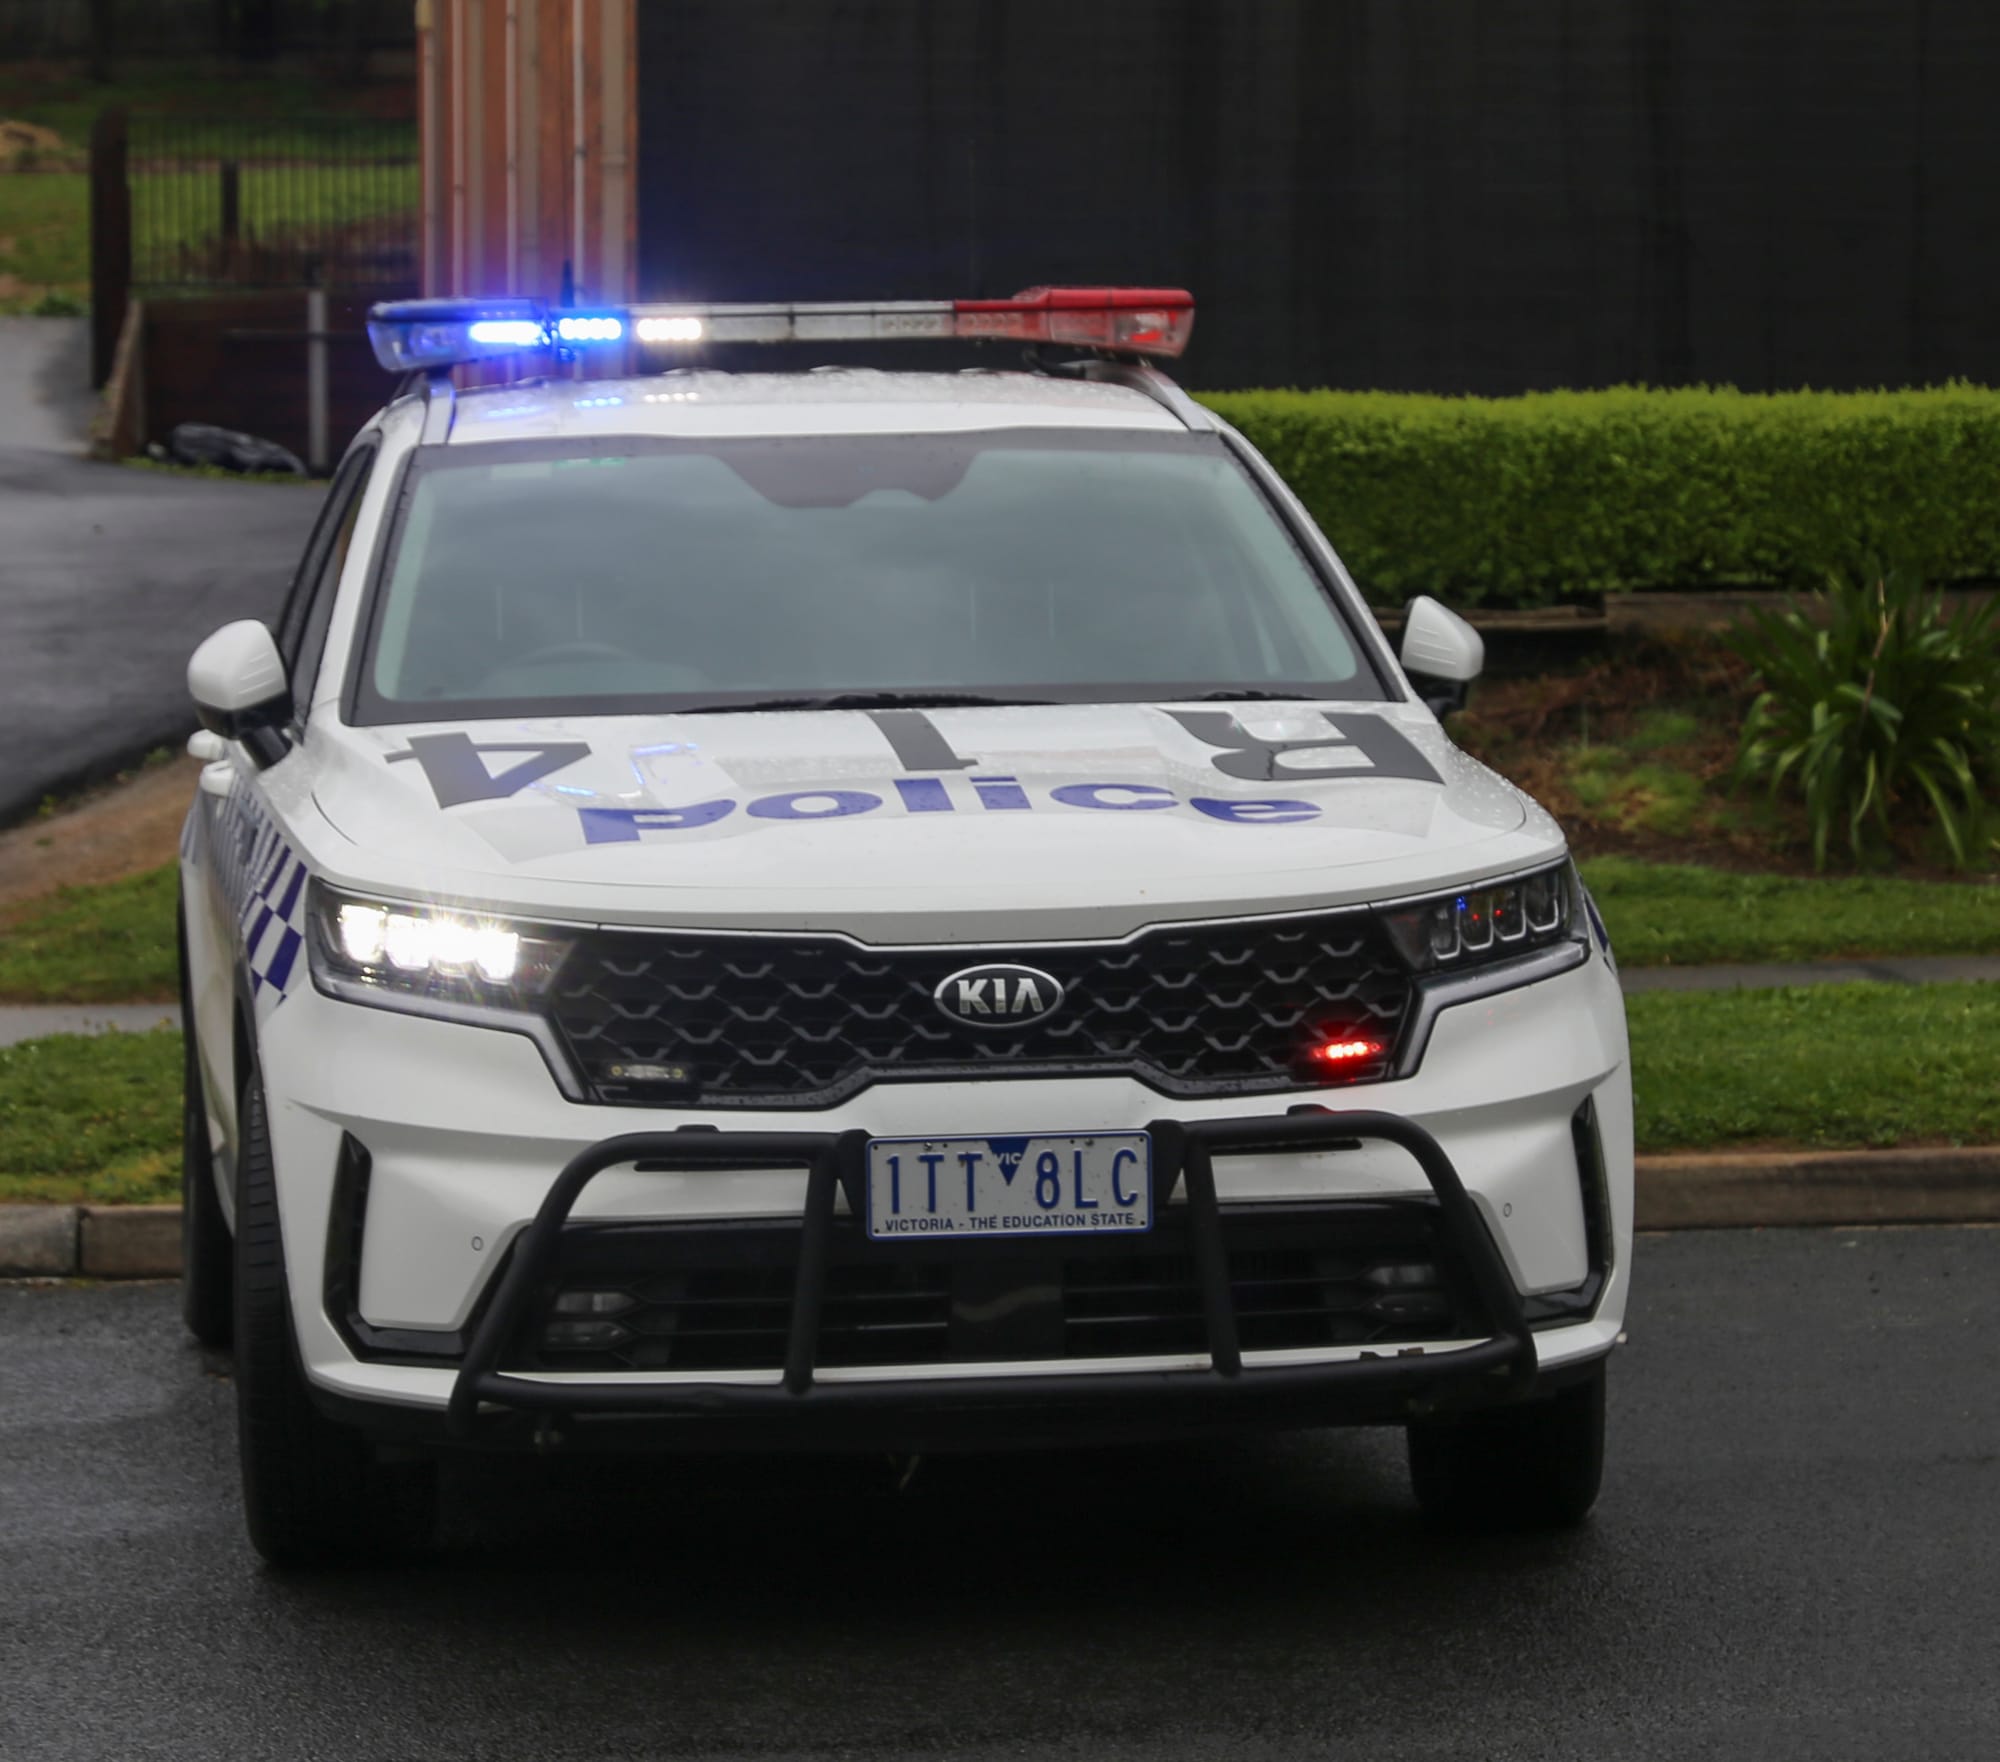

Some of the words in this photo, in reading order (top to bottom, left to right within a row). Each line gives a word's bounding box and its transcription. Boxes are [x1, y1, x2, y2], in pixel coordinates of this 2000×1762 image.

[577, 776, 1322, 844] police
[956, 978, 1044, 1014] KIA
[993, 1152, 1021, 1165] VIC
[886, 1152, 983, 1214] 1TT
[1035, 1149, 1138, 1209] 8LC
[885, 1218, 954, 1231] VICTORIA
[969, 1216, 997, 1229] THE
[1003, 1214, 1085, 1228] EDUCATION
[1091, 1212, 1133, 1226] STATE
